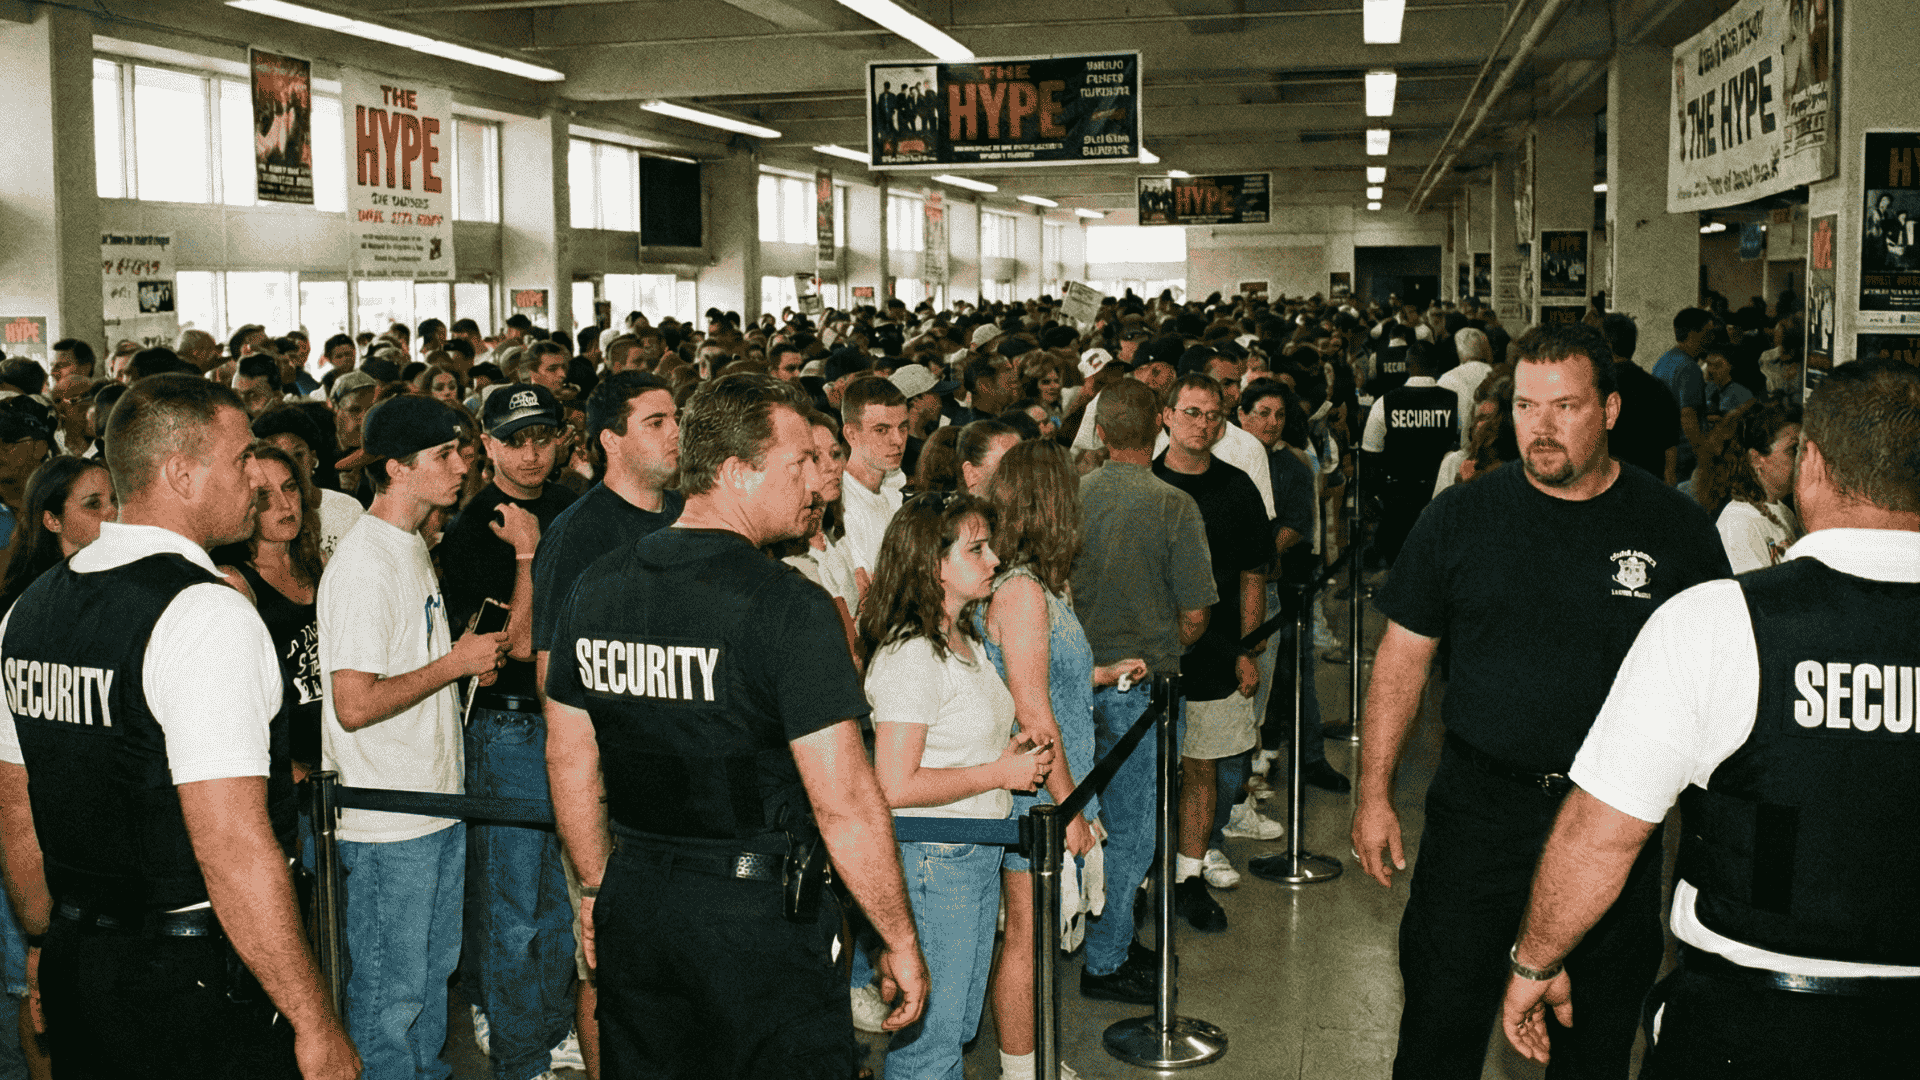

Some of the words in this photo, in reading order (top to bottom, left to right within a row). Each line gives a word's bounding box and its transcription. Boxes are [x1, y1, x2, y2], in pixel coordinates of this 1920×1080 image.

[980, 64, 1031, 80] THE
[380, 85, 418, 111] THE
[948, 79, 1067, 140] HYPE
[1687, 88, 1717, 161] THE
[1721, 56, 1776, 151] HYPE
[356, 104, 442, 194] HYPE
[1889, 147, 1920, 187] H
[1175, 185, 1236, 215] HYPE
[5, 322, 40, 343] HYPE
[1391, 409, 1451, 428] SECURITY
[4, 657, 114, 728] SECURITY
[576, 637, 719, 702] SECURITY
[1794, 659, 1920, 734] SECU
